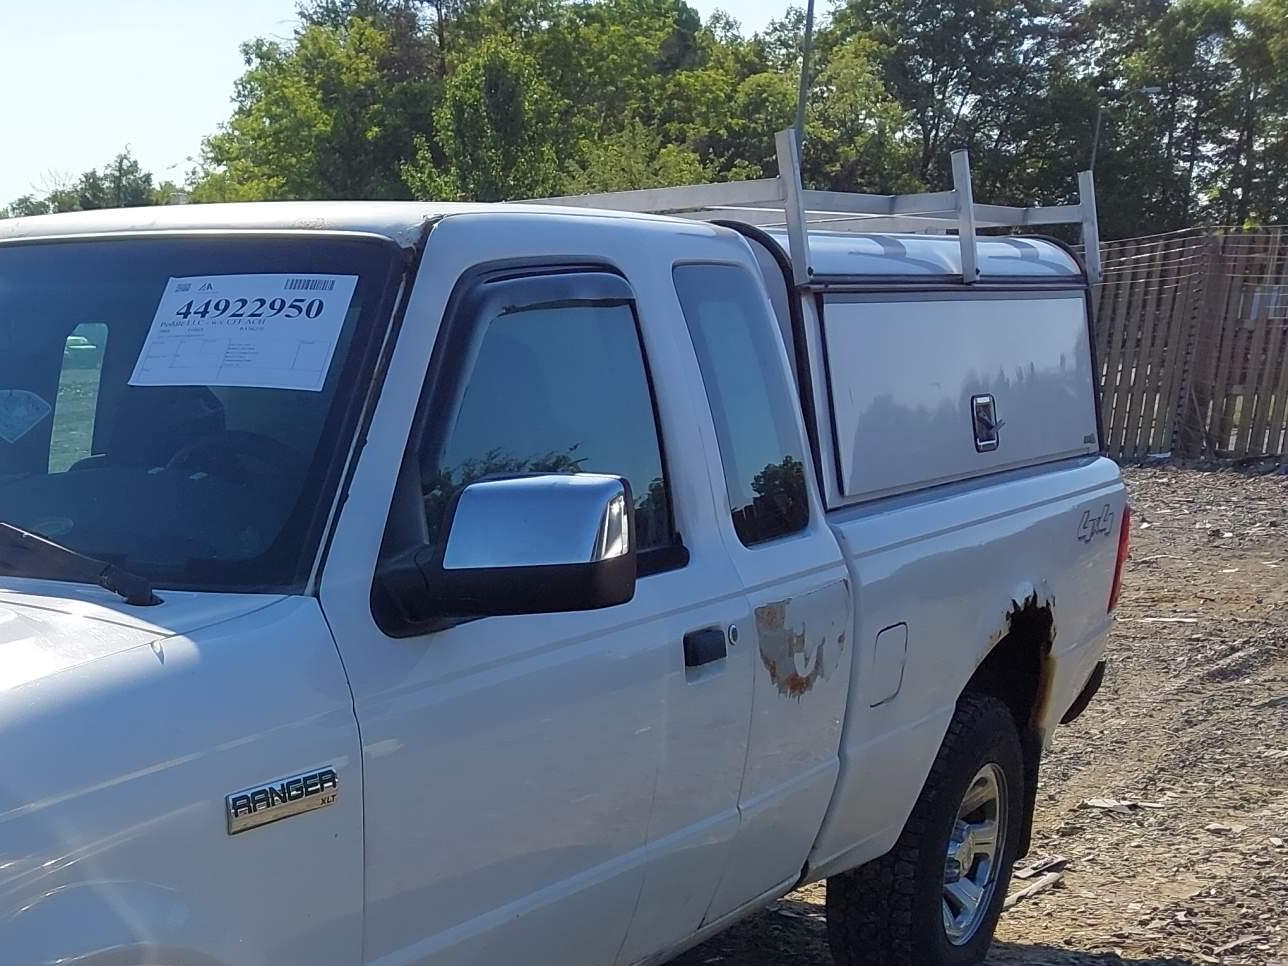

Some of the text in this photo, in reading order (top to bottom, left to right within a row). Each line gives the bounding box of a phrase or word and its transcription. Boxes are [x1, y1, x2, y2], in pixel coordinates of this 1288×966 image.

[175, 297, 325, 320] 44922950
[231, 768, 338, 818] RANGER
[319, 794, 337, 806] XLT
